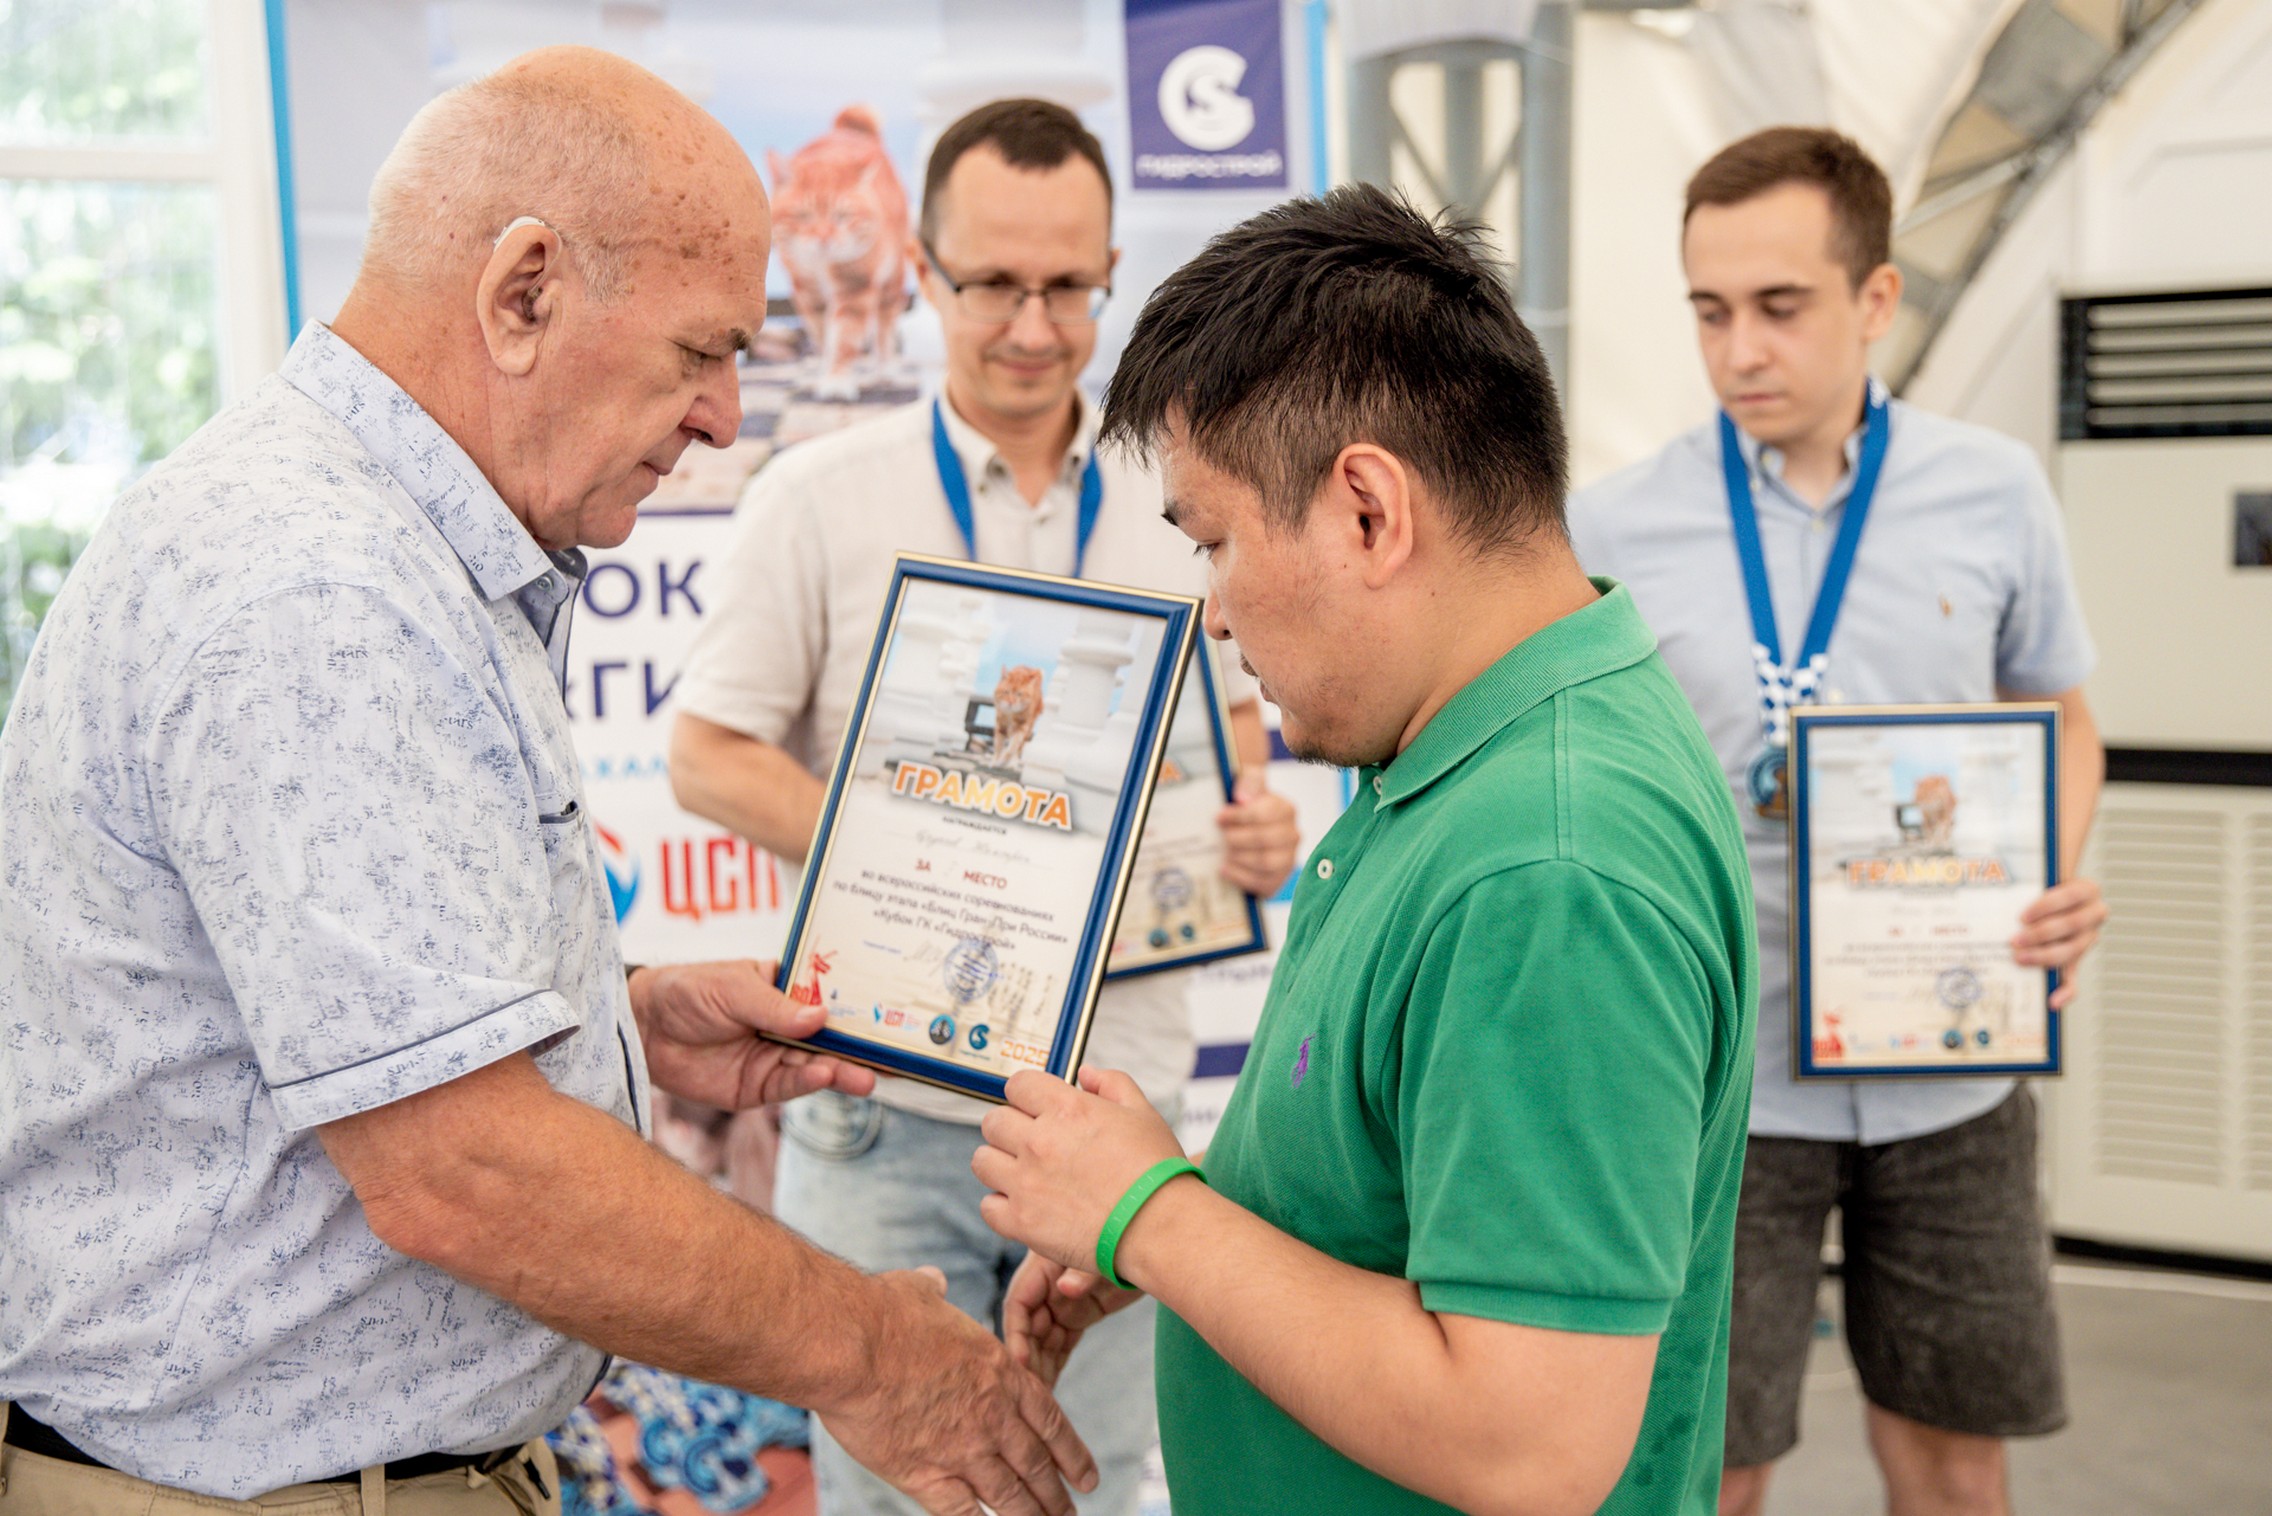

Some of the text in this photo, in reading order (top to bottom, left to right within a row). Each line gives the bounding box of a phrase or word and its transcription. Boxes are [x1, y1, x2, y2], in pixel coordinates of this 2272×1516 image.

[582, 560, 704, 619] ОК
[894, 762, 1070, 829] ГРАМОТА
[877, 874, 961, 901] всероссийских
[964, 892, 1054, 922] соревнованиях
[915, 858, 1008, 889] ЗА МЕСТО
